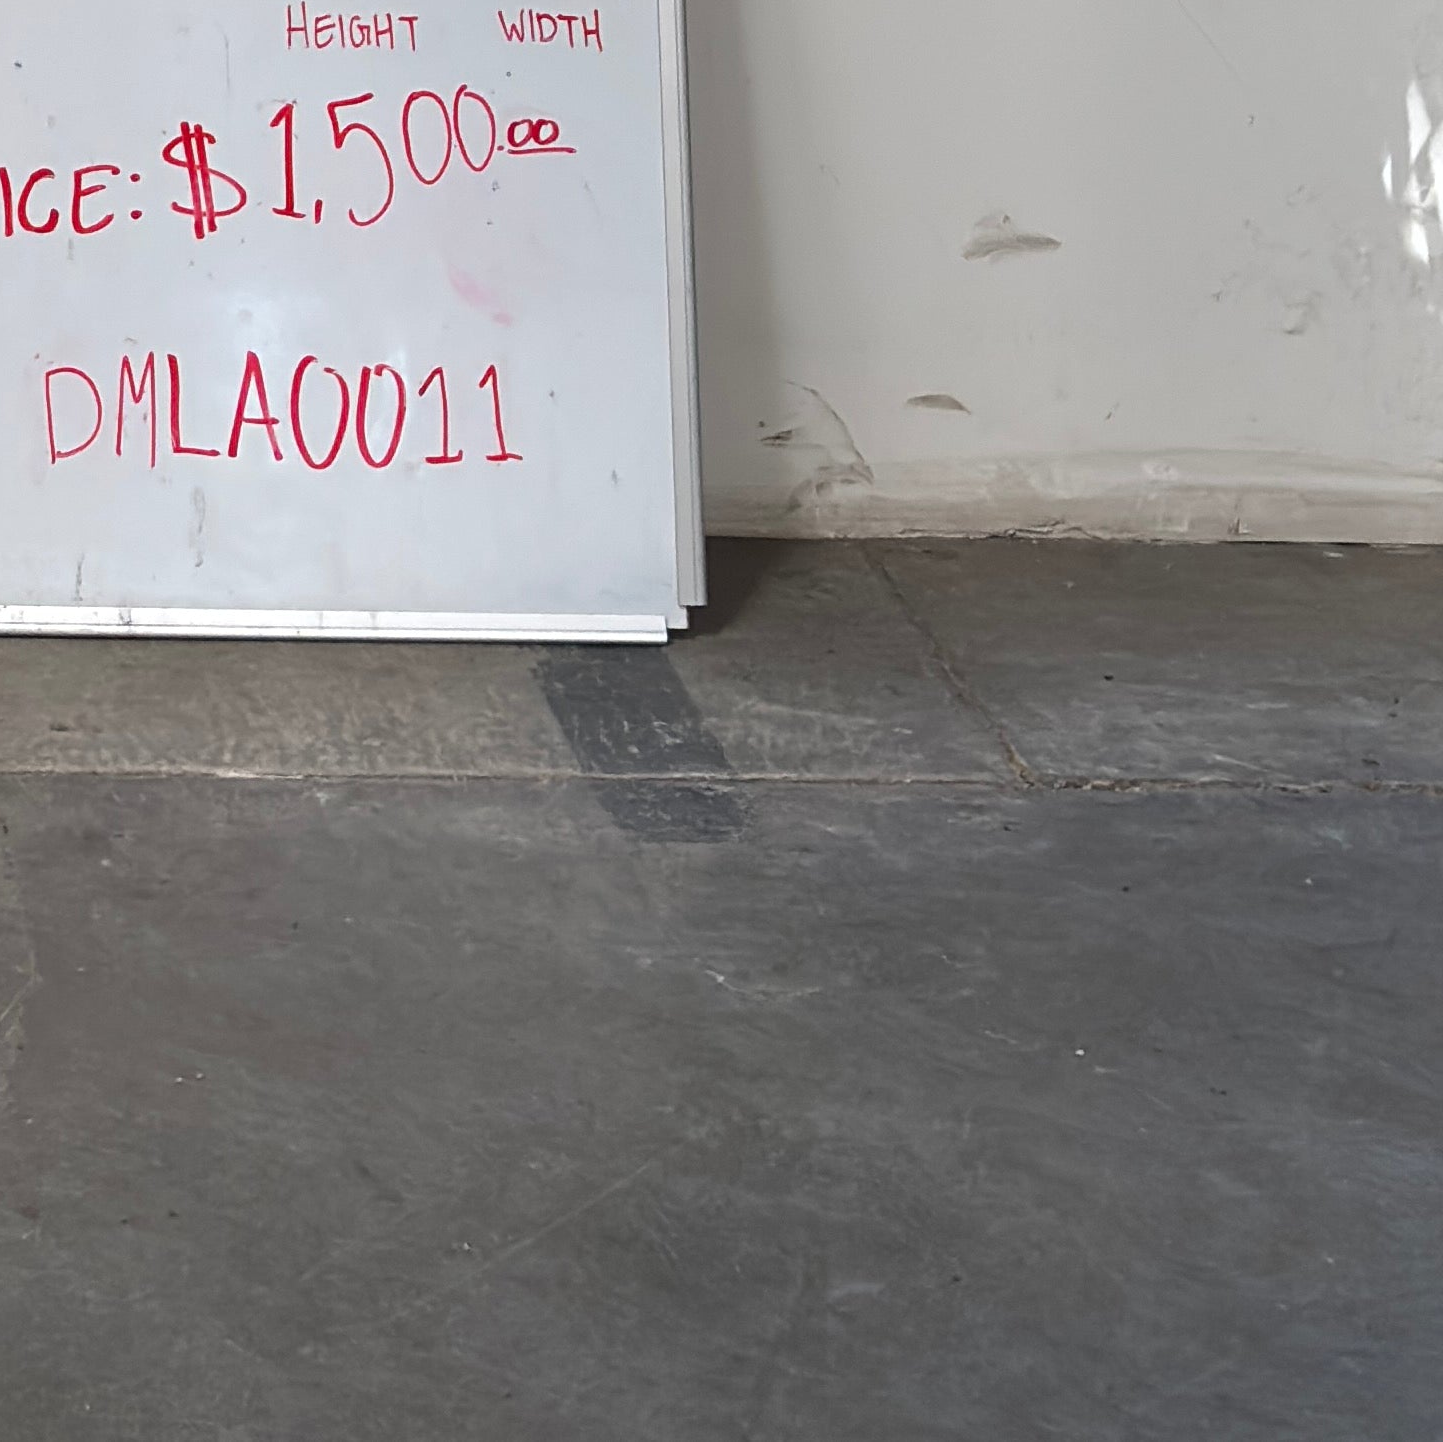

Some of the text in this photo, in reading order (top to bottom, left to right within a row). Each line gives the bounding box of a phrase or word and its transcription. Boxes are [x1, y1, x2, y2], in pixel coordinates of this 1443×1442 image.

[287, 6, 601, 49] HEIGHT WIDTH
[44, 351, 521, 470] DMLA0011
